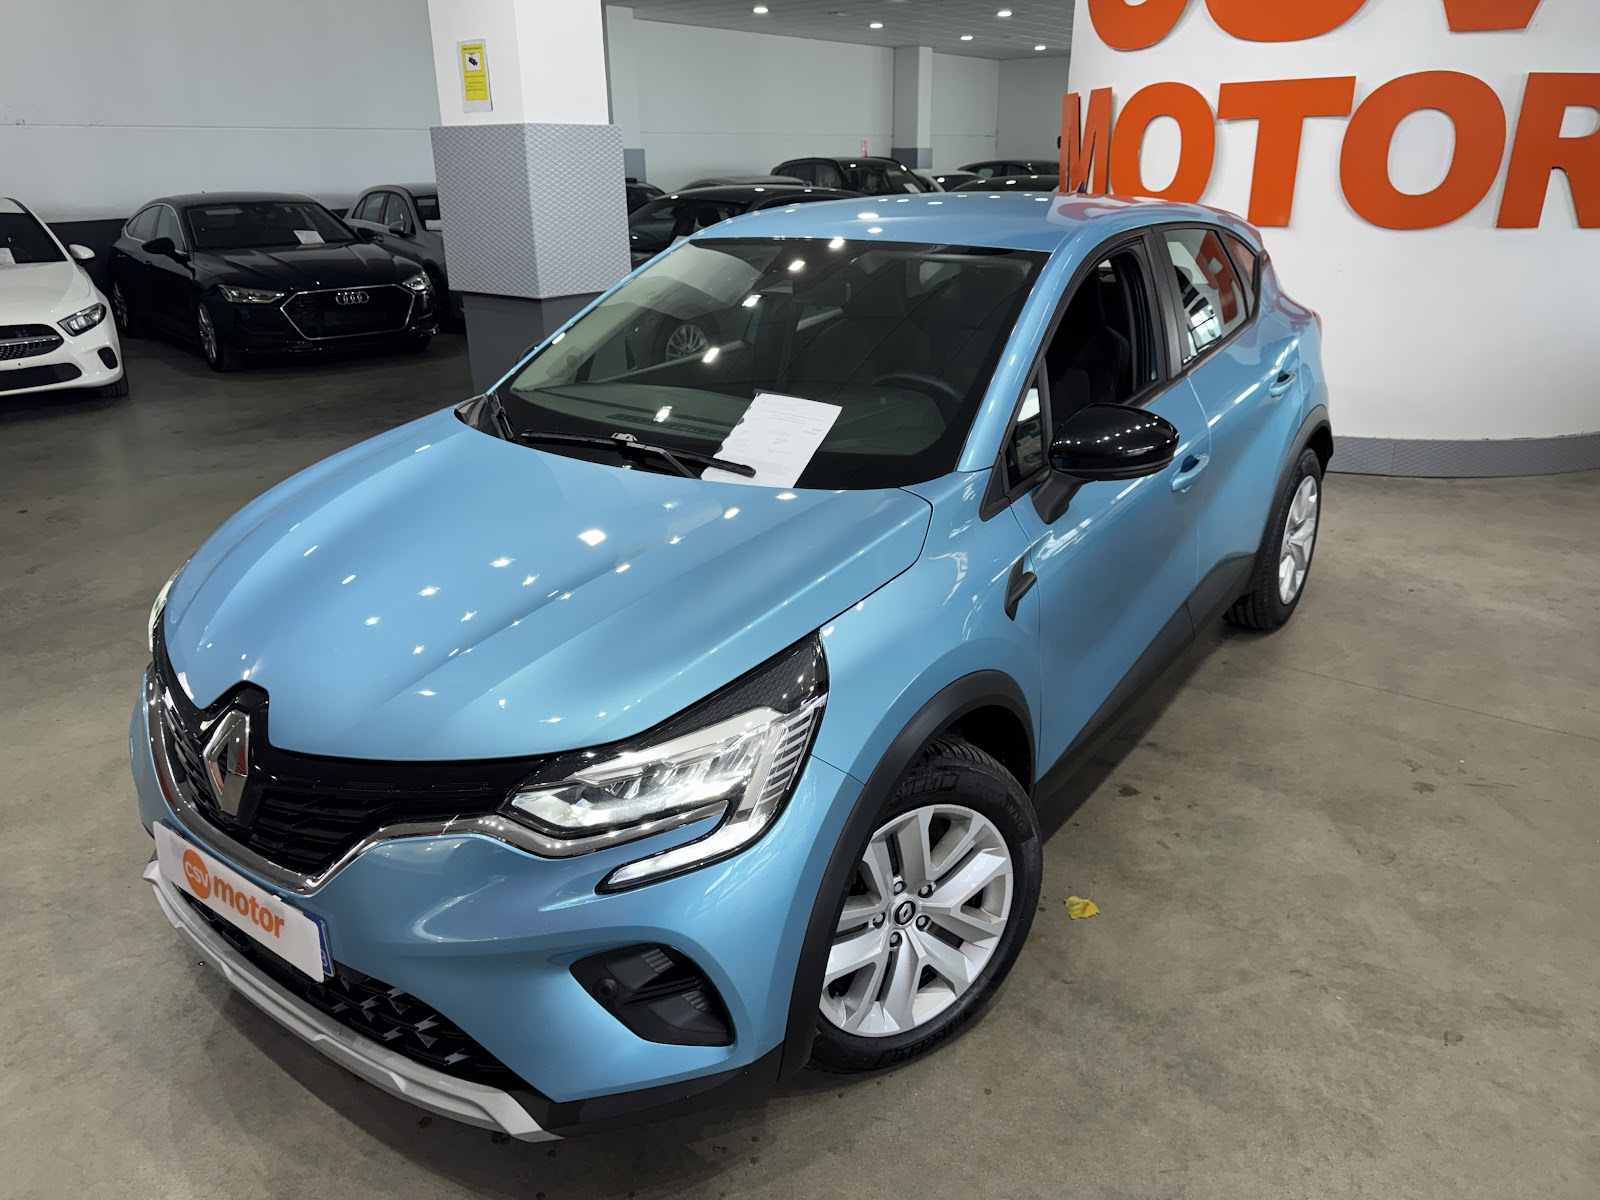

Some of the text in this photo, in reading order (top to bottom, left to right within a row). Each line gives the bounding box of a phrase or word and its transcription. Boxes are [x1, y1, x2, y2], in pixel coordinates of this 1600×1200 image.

[1059, 70, 1600, 229] MOTOR
[184, 860, 209, 888] CSV
[213, 874, 285, 939] motor
